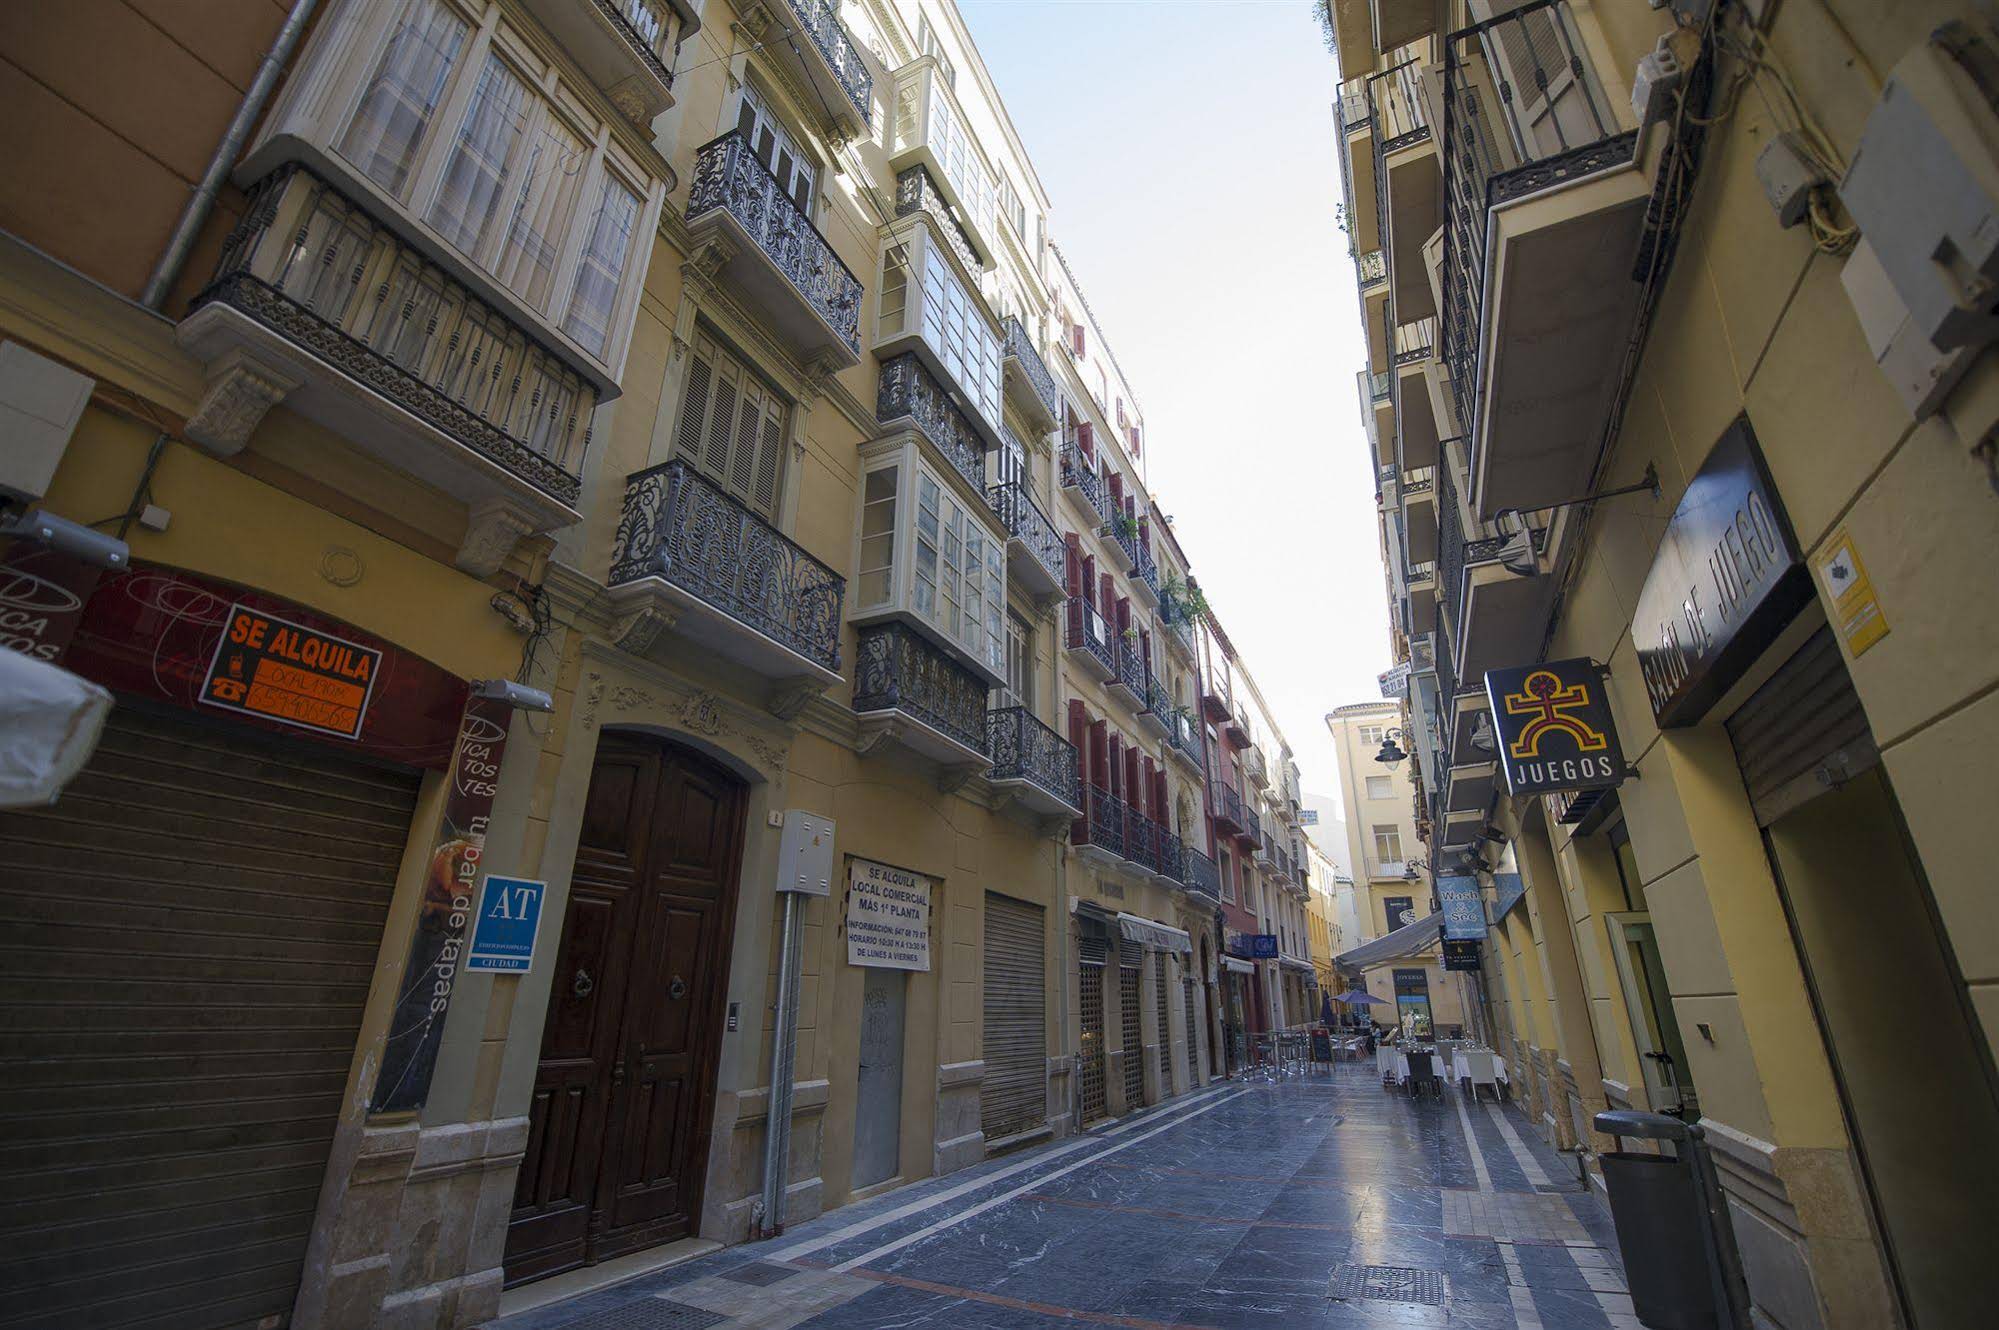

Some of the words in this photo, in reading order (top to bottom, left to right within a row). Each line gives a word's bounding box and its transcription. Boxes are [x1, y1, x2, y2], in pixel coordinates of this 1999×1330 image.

[1645, 621, 1690, 714] SALÓN
[1682, 584, 1714, 659] DE
[1709, 489, 1778, 624] JUEGO
[230, 614, 269, 649] SE
[268, 627, 372, 681] ALQUILA
[464, 759, 498, 778] TOS
[1517, 756, 1612, 785] JUEGOS
[463, 779, 497, 797] TES
[467, 815, 490, 850] tu
[458, 846, 484, 889] bar
[868, 867, 880, 880] SE
[882, 871, 916, 888] ALQUILA
[487, 885, 537, 921] AT
[852, 880, 881, 896] LOCAL
[882, 887, 927, 906] COMERCIAL
[1442, 890, 1478, 901] Wash
[449, 894, 472, 929] de
[890, 904, 920, 920] PLANTA
[1456, 902, 1466, 912] &
[848, 934, 877, 945] HORARIO
[482, 958, 519, 968] CIUDAD
[857, 948, 866, 956] DE
[867, 949, 887, 959] LUNES
[893, 952, 918, 962] VIERNES
